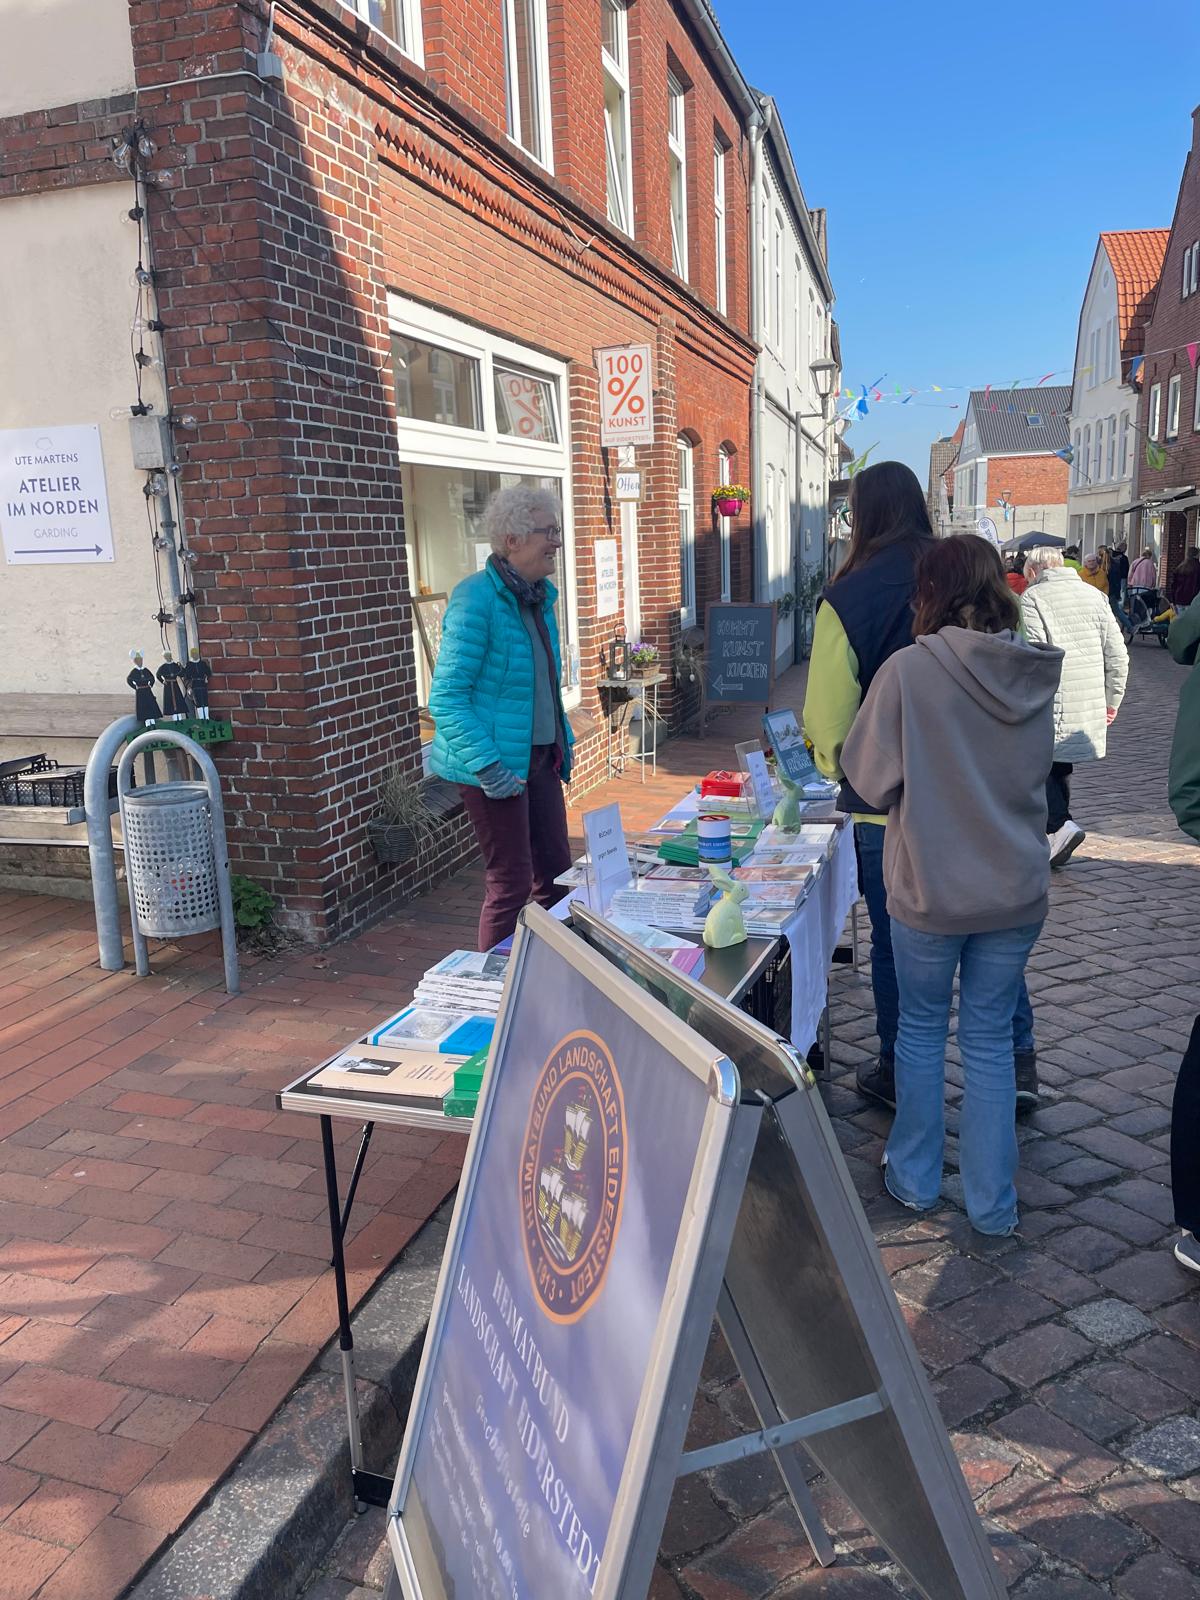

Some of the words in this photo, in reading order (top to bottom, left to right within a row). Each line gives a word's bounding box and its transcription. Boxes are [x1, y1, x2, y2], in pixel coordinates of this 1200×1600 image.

[606, 354, 643, 375] 100
[608, 416, 646, 428] KUNST
[15, 456, 32, 466] UTE
[34, 453, 79, 465] MARTENS
[19, 476, 81, 494] ATELIER
[7, 503, 26, 517] IM
[31, 499, 99, 516] NORDEN
[34, 527, 79, 539] GARDING
[722, 641, 765, 657] KUNST
[558, 1047, 619, 1135] LANDSCHAFT
[523, 1065, 559, 1230] HEIMATBUND
[569, 1146, 620, 1305] EIDERSTEDT
[534, 1254, 557, 1301] 1913
[492, 1268, 569, 1444] HEIMATBUND
[456, 1264, 519, 1407] LANDSCHAFT
[516, 1396, 602, 1597] EIDERSTEDT
